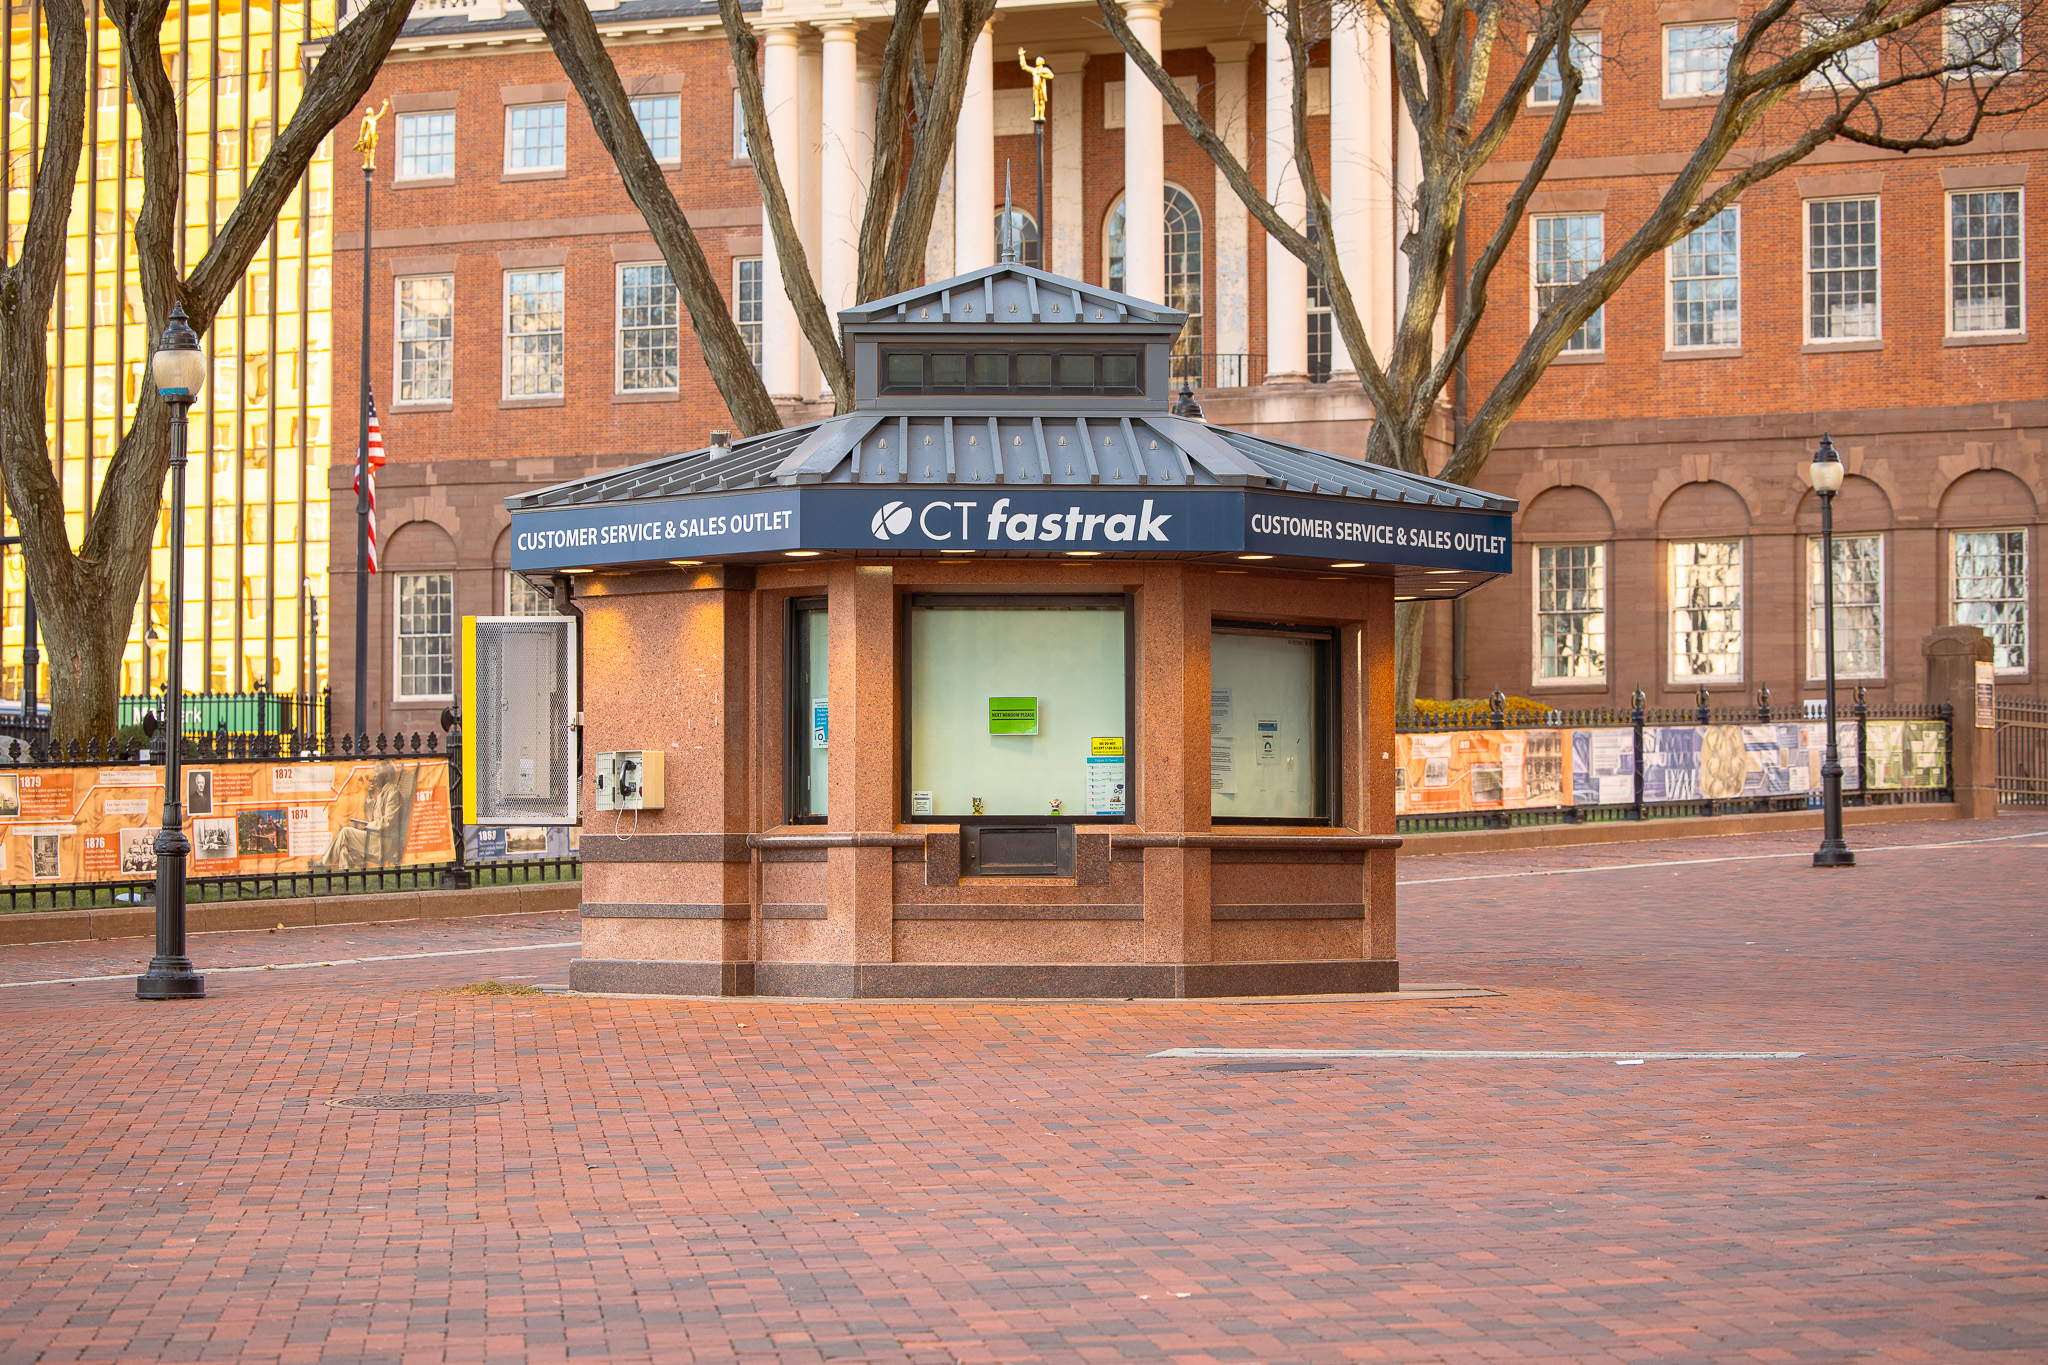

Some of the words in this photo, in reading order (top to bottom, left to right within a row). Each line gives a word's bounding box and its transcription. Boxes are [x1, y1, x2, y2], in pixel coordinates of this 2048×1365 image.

[987, 497, 1173, 542] fastrak
[517, 527, 598, 551] CUSTOMER
[600, 522, 661, 546] SERVICE
[665, 521, 676, 539] &
[680, 516, 726, 537] SALES
[730, 510, 792, 533] OUTLET
[1251, 513, 1333, 540] CUSTOMER
[1336, 522, 1393, 544] SERVICE
[1397, 527, 1407, 546] &
[1410, 528, 1452, 550] SALES
[1455, 533, 1506, 554] OUTLET
[274, 768, 293, 779] 1872
[20, 776, 41, 787] 1879
[291, 809, 308, 819] 1874
[85, 837, 105, 849] 1876
